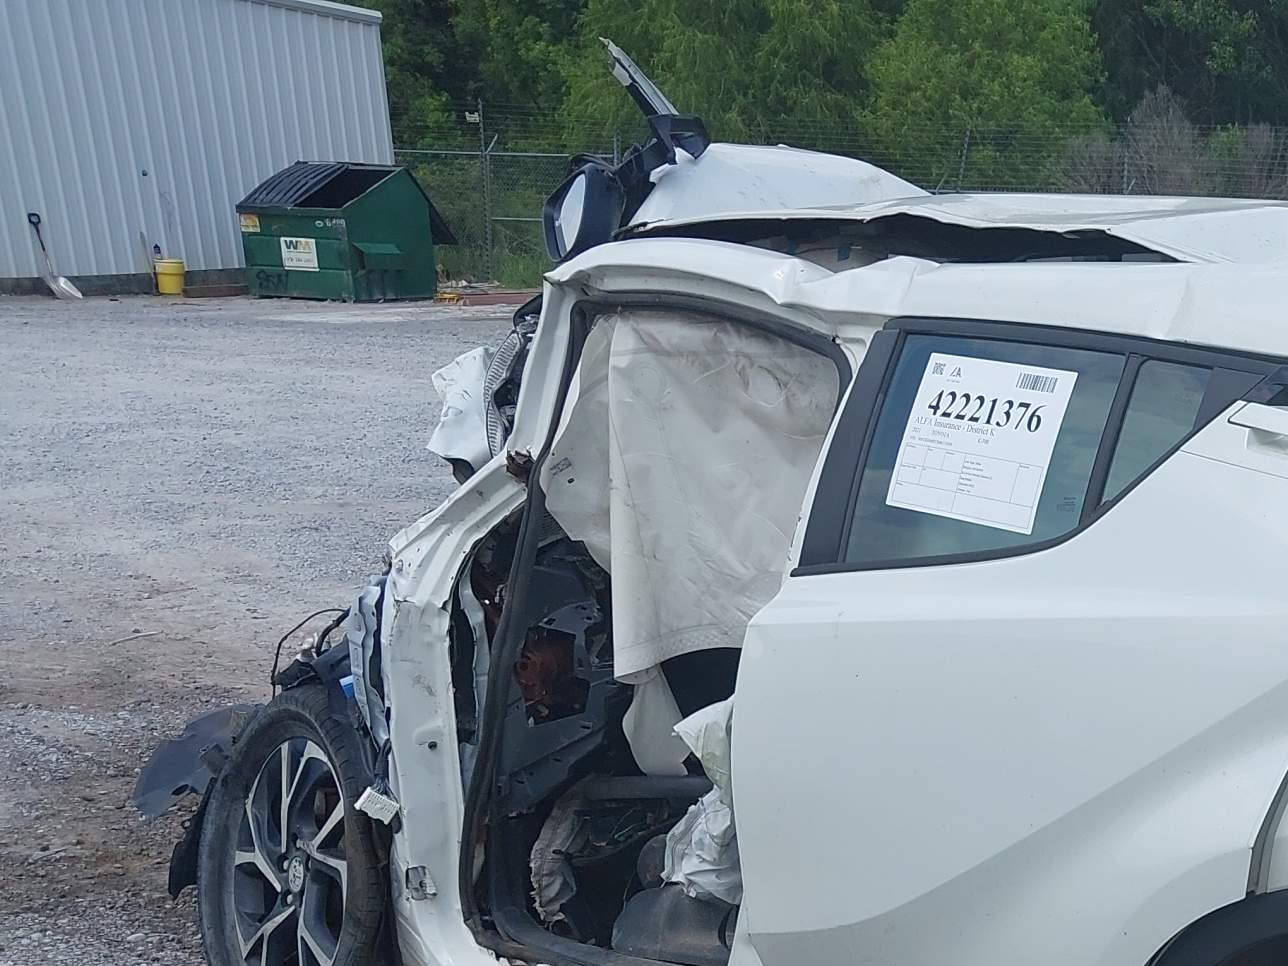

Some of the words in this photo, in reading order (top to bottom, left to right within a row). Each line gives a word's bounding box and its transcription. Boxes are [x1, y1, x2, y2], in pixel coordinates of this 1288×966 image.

[927, 389, 1048, 433] 42221376
[934, 418, 962, 431] Insurance
[966, 424, 989, 436] District
